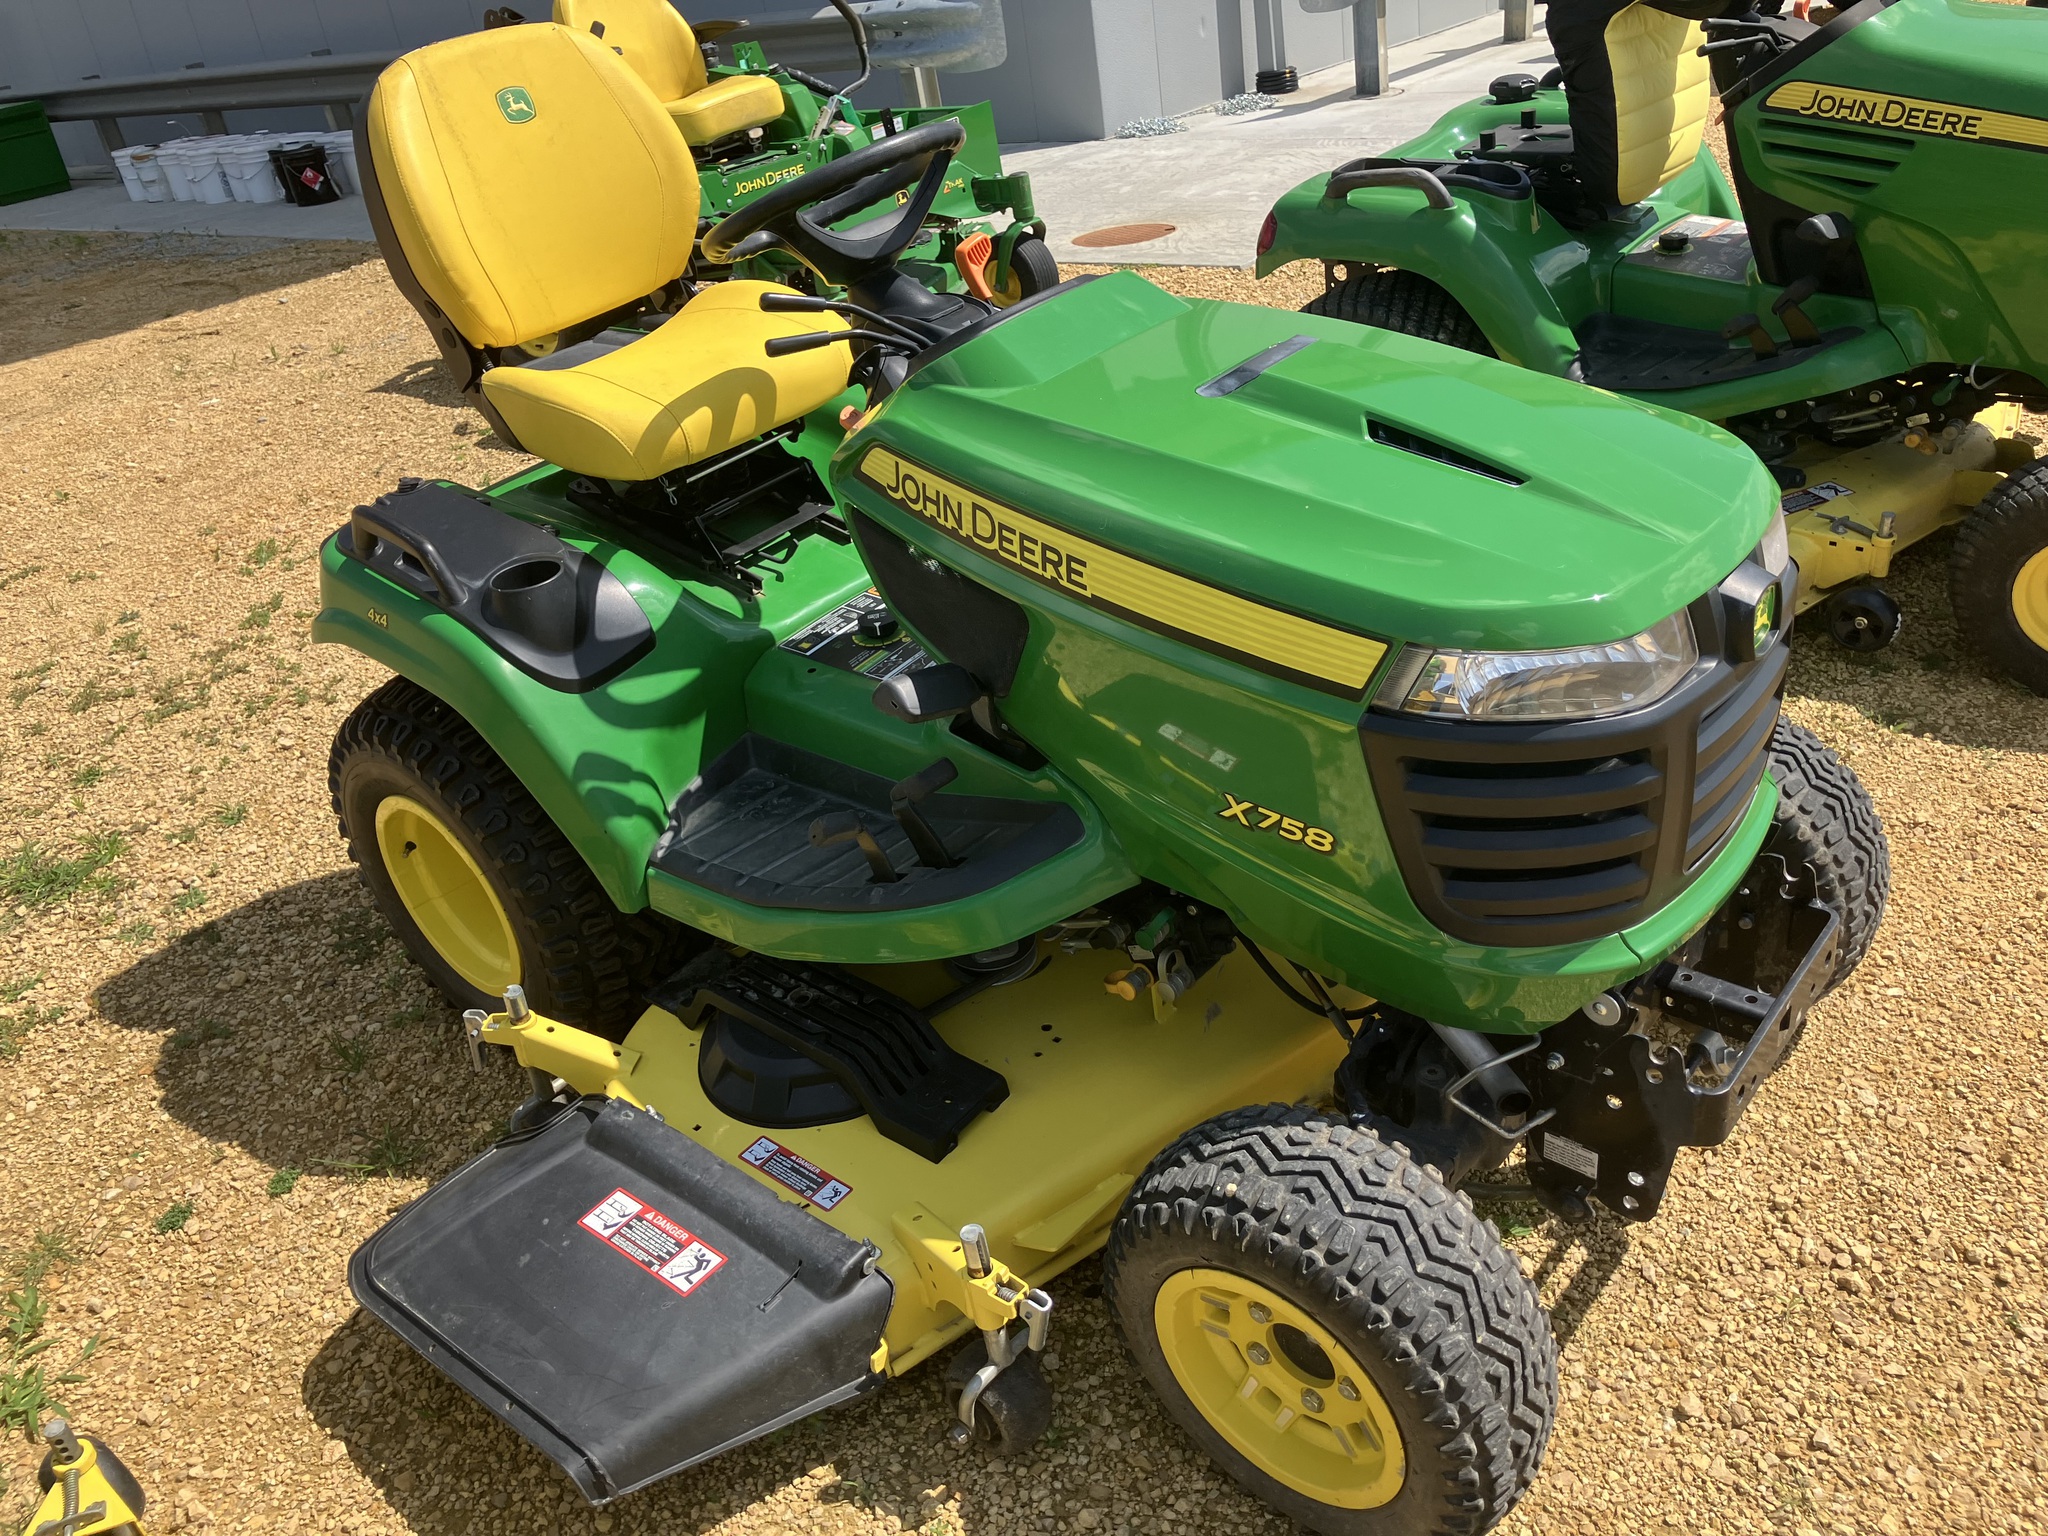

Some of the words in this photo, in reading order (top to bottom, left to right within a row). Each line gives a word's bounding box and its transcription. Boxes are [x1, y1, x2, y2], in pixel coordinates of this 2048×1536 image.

[1800, 89, 1877, 121] JOHN
[1881, 100, 1983, 136] DEERE
[733, 177, 766, 197] JOHN
[765, 164, 806, 186] DEERE
[886, 460, 964, 532] JOHN
[971, 501, 1088, 592] DEERE
[367, 608, 388, 628] 4x4
[1218, 792, 1335, 853] X758
[796, 1157, 821, 1175] DANGER
[653, 1215, 689, 1242] DANGER
